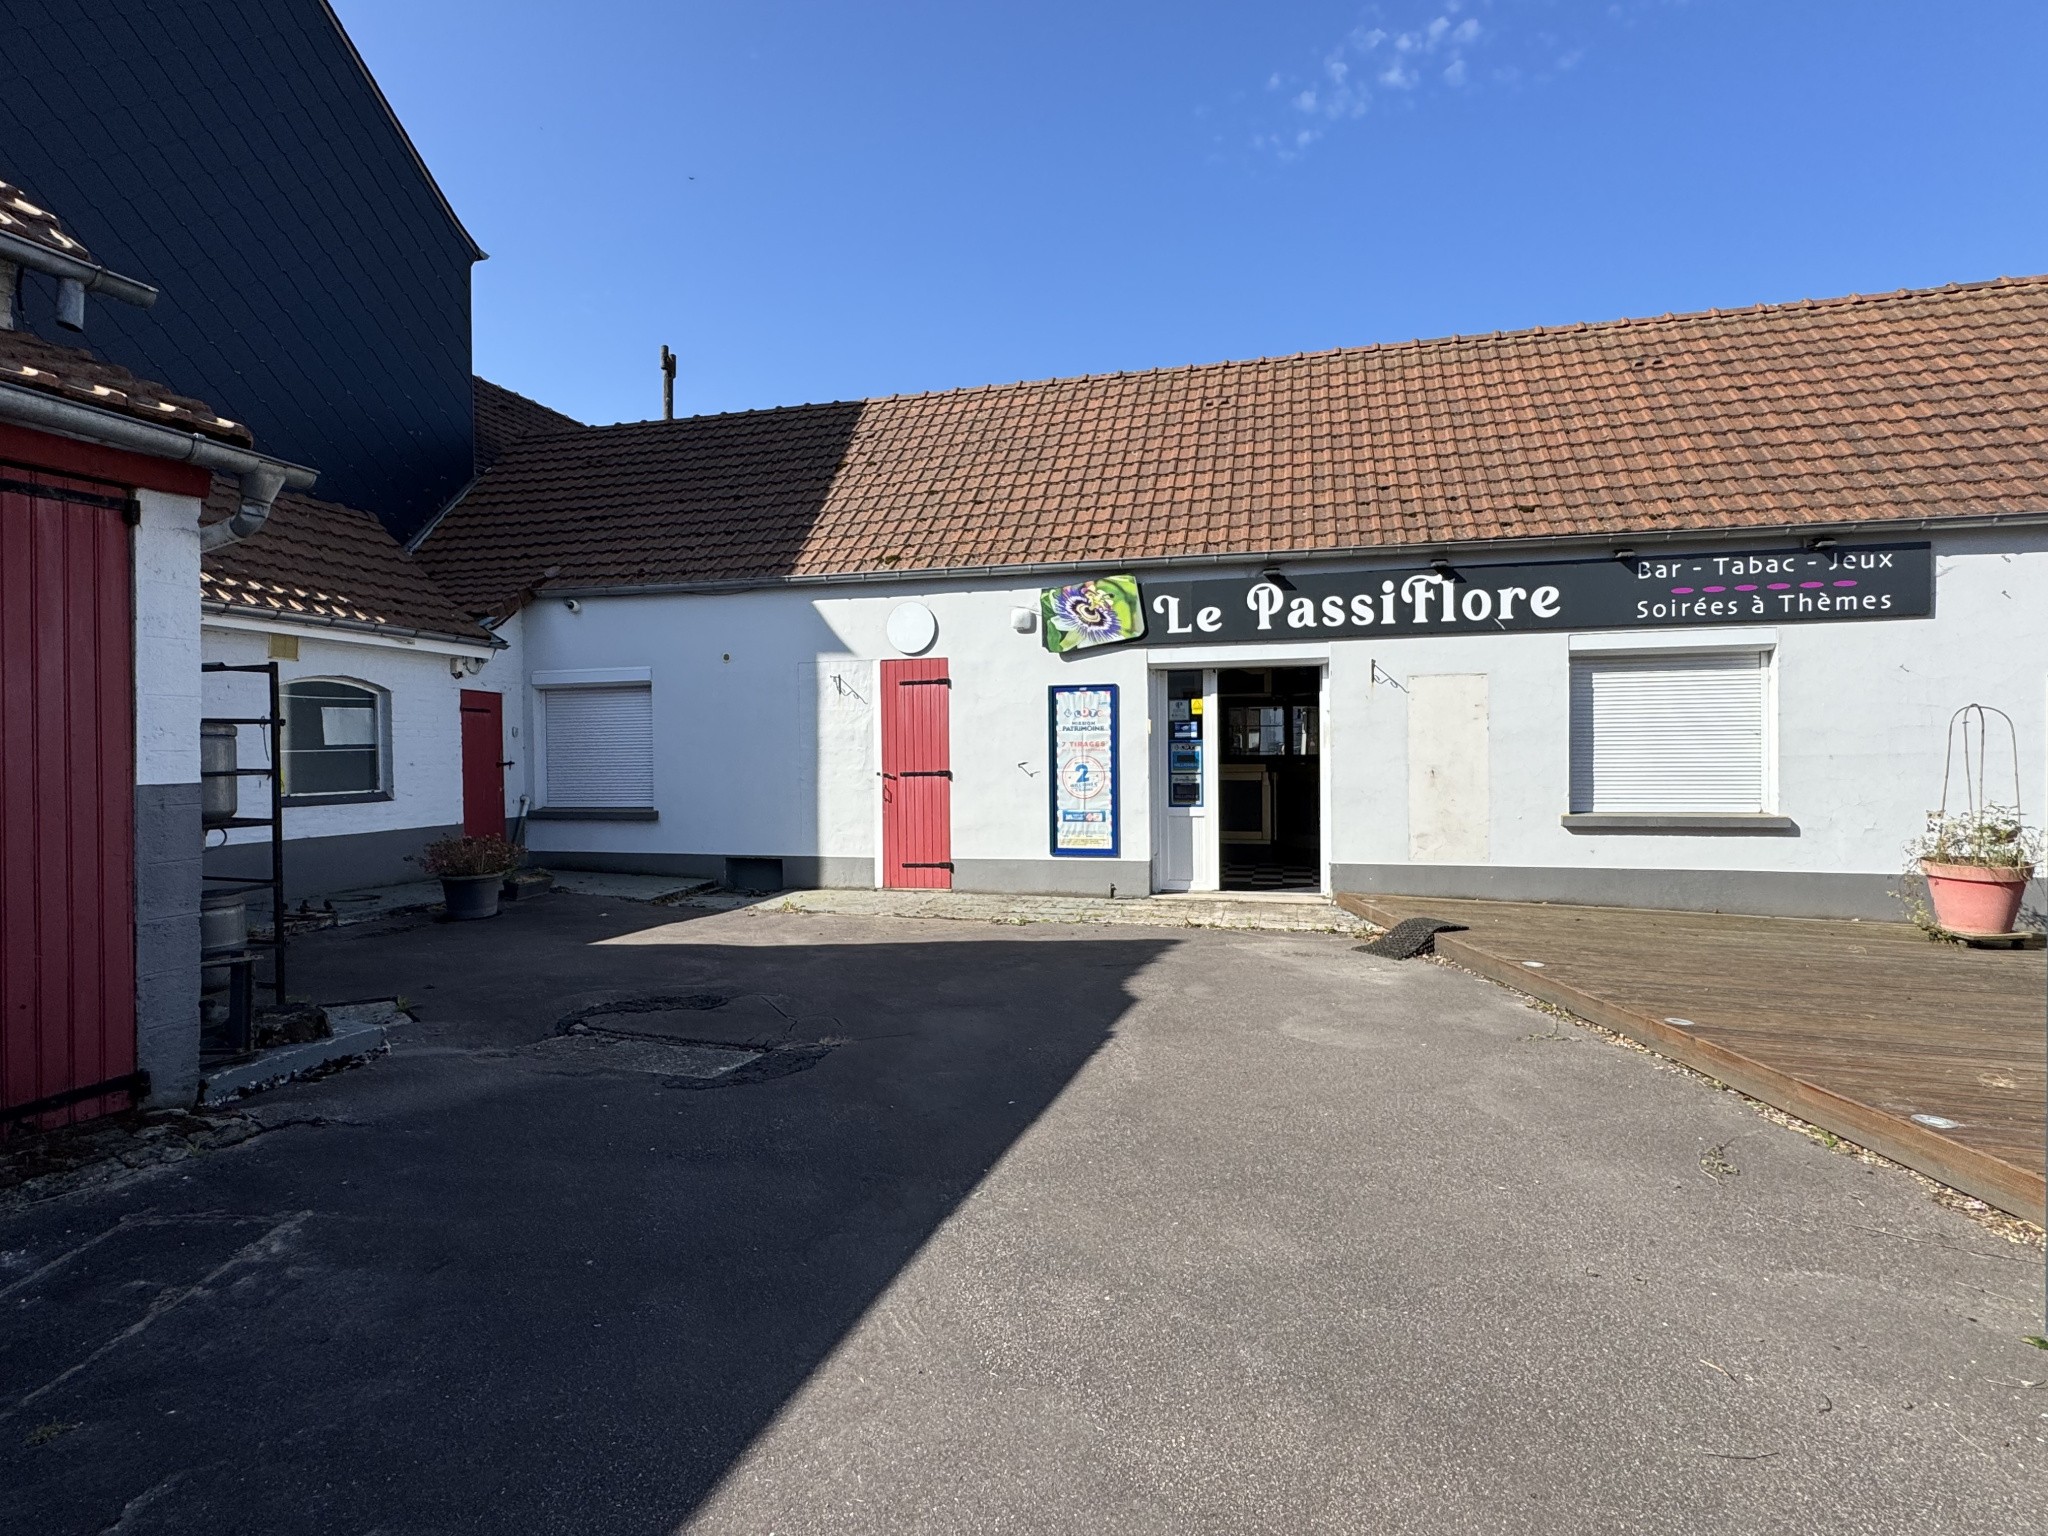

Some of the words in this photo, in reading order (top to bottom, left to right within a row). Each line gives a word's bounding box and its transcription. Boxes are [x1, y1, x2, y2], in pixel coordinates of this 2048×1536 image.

[1637, 561, 1682, 579] Bar
[1713, 556, 1795, 576] Tabac
[1829, 552, 1893, 571] Jeux
[1152, 594, 1223, 634] Le
[1246, 574, 1561, 630] PassiFlore
[1637, 598, 1738, 619] Soirées
[1751, 594, 1764, 614] à
[1778, 592, 1892, 613] Thèmes
[1075, 764, 1089, 783] 2
